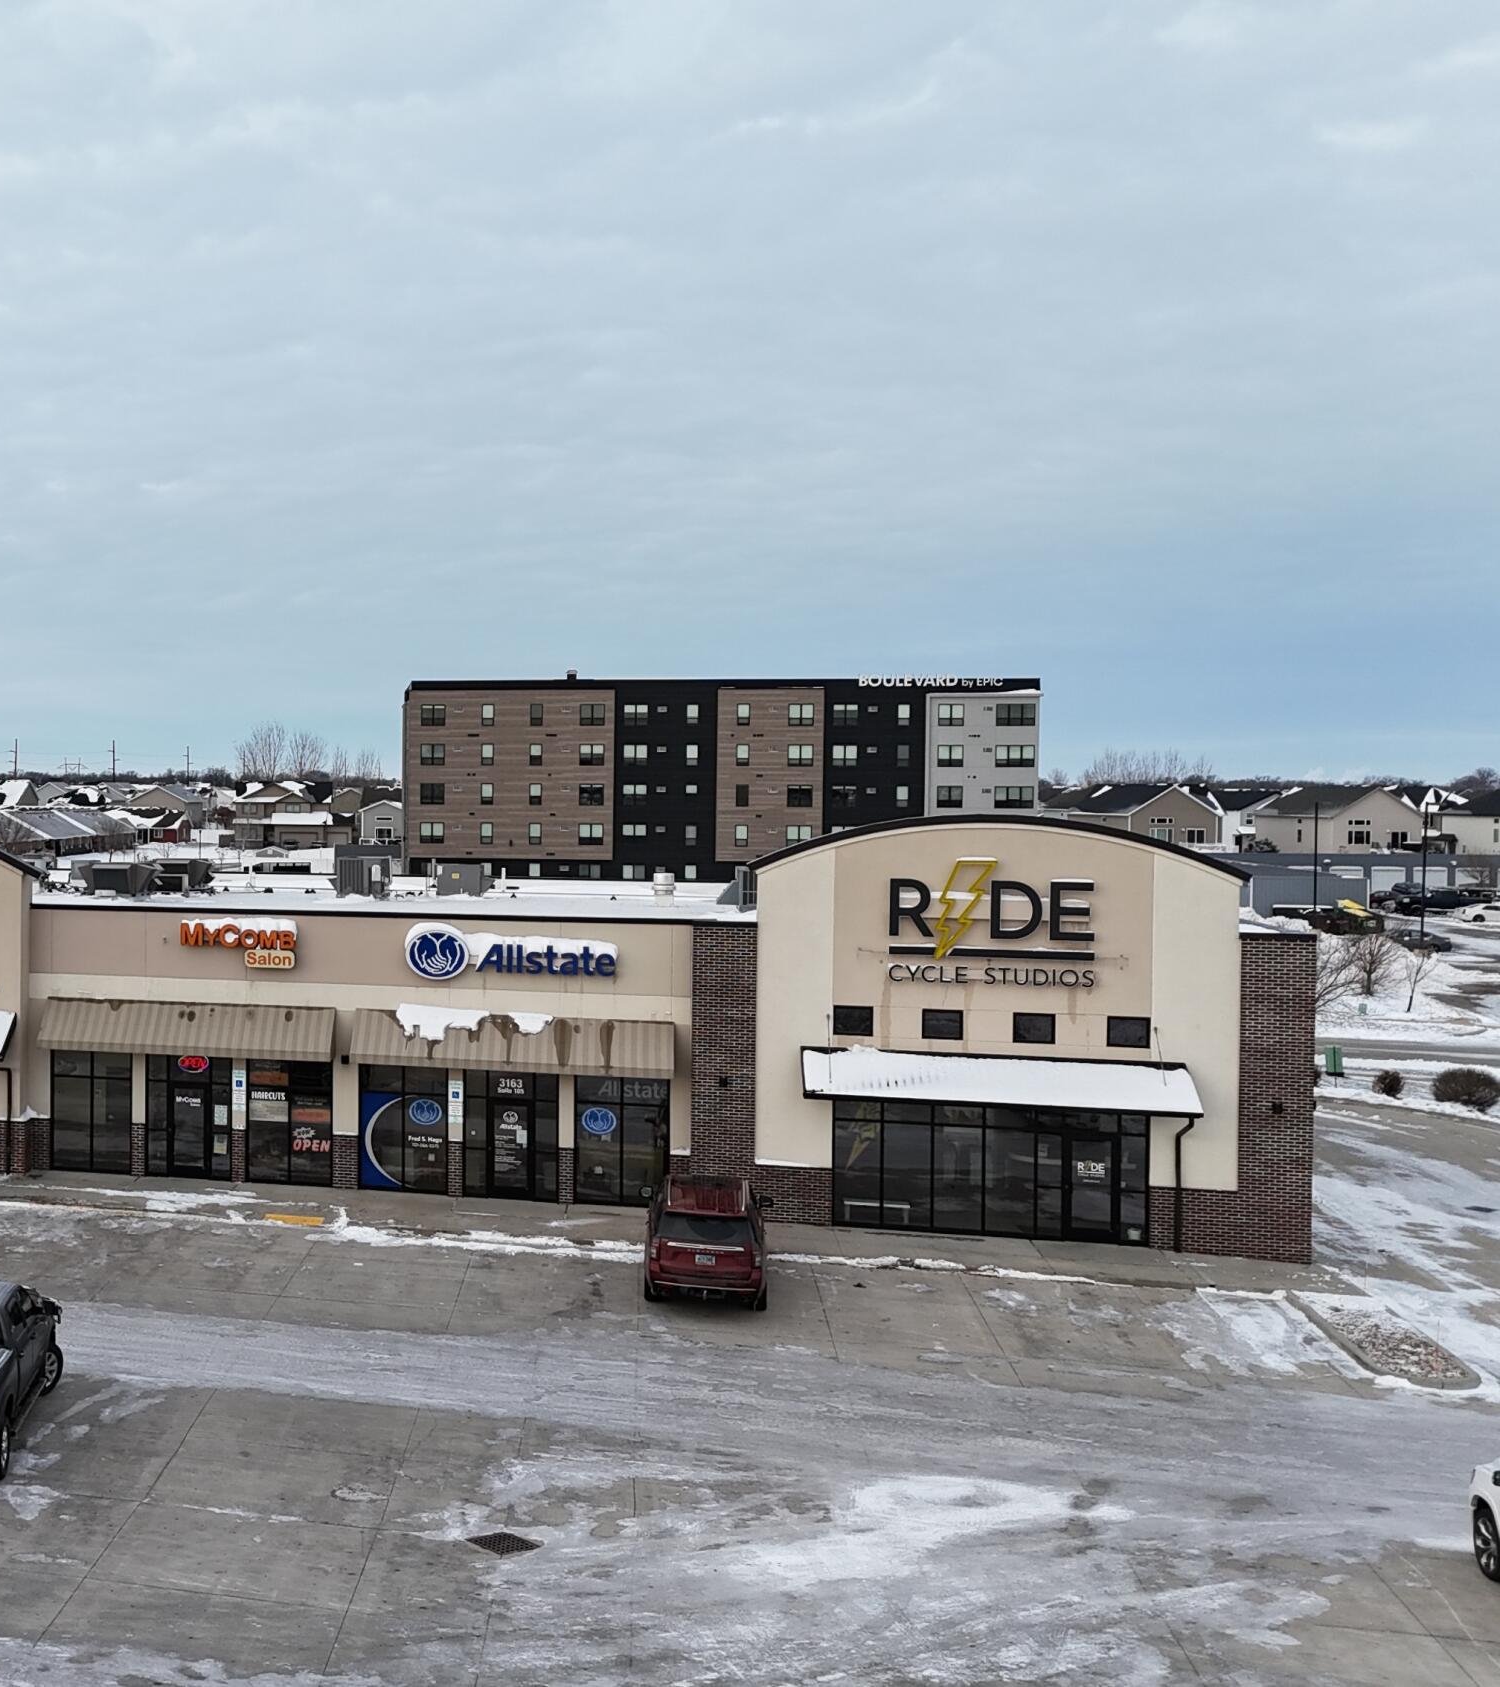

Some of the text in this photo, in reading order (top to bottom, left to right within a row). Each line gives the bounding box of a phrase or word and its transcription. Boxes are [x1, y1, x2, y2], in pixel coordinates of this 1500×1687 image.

[858, 674, 1003, 688] BOULEVARD by EPIC
[246, 951, 292, 966] Salon
[475, 943, 616, 977] Allstate
[888, 964, 1095, 988] CYCLE STUDIOS
[180, 1056, 207, 1069] OPEN
[499, 1078, 523, 1088] 3163
[251, 1091, 286, 1100] HAIRCUTS
[293, 1139, 331, 1153] OPEN
